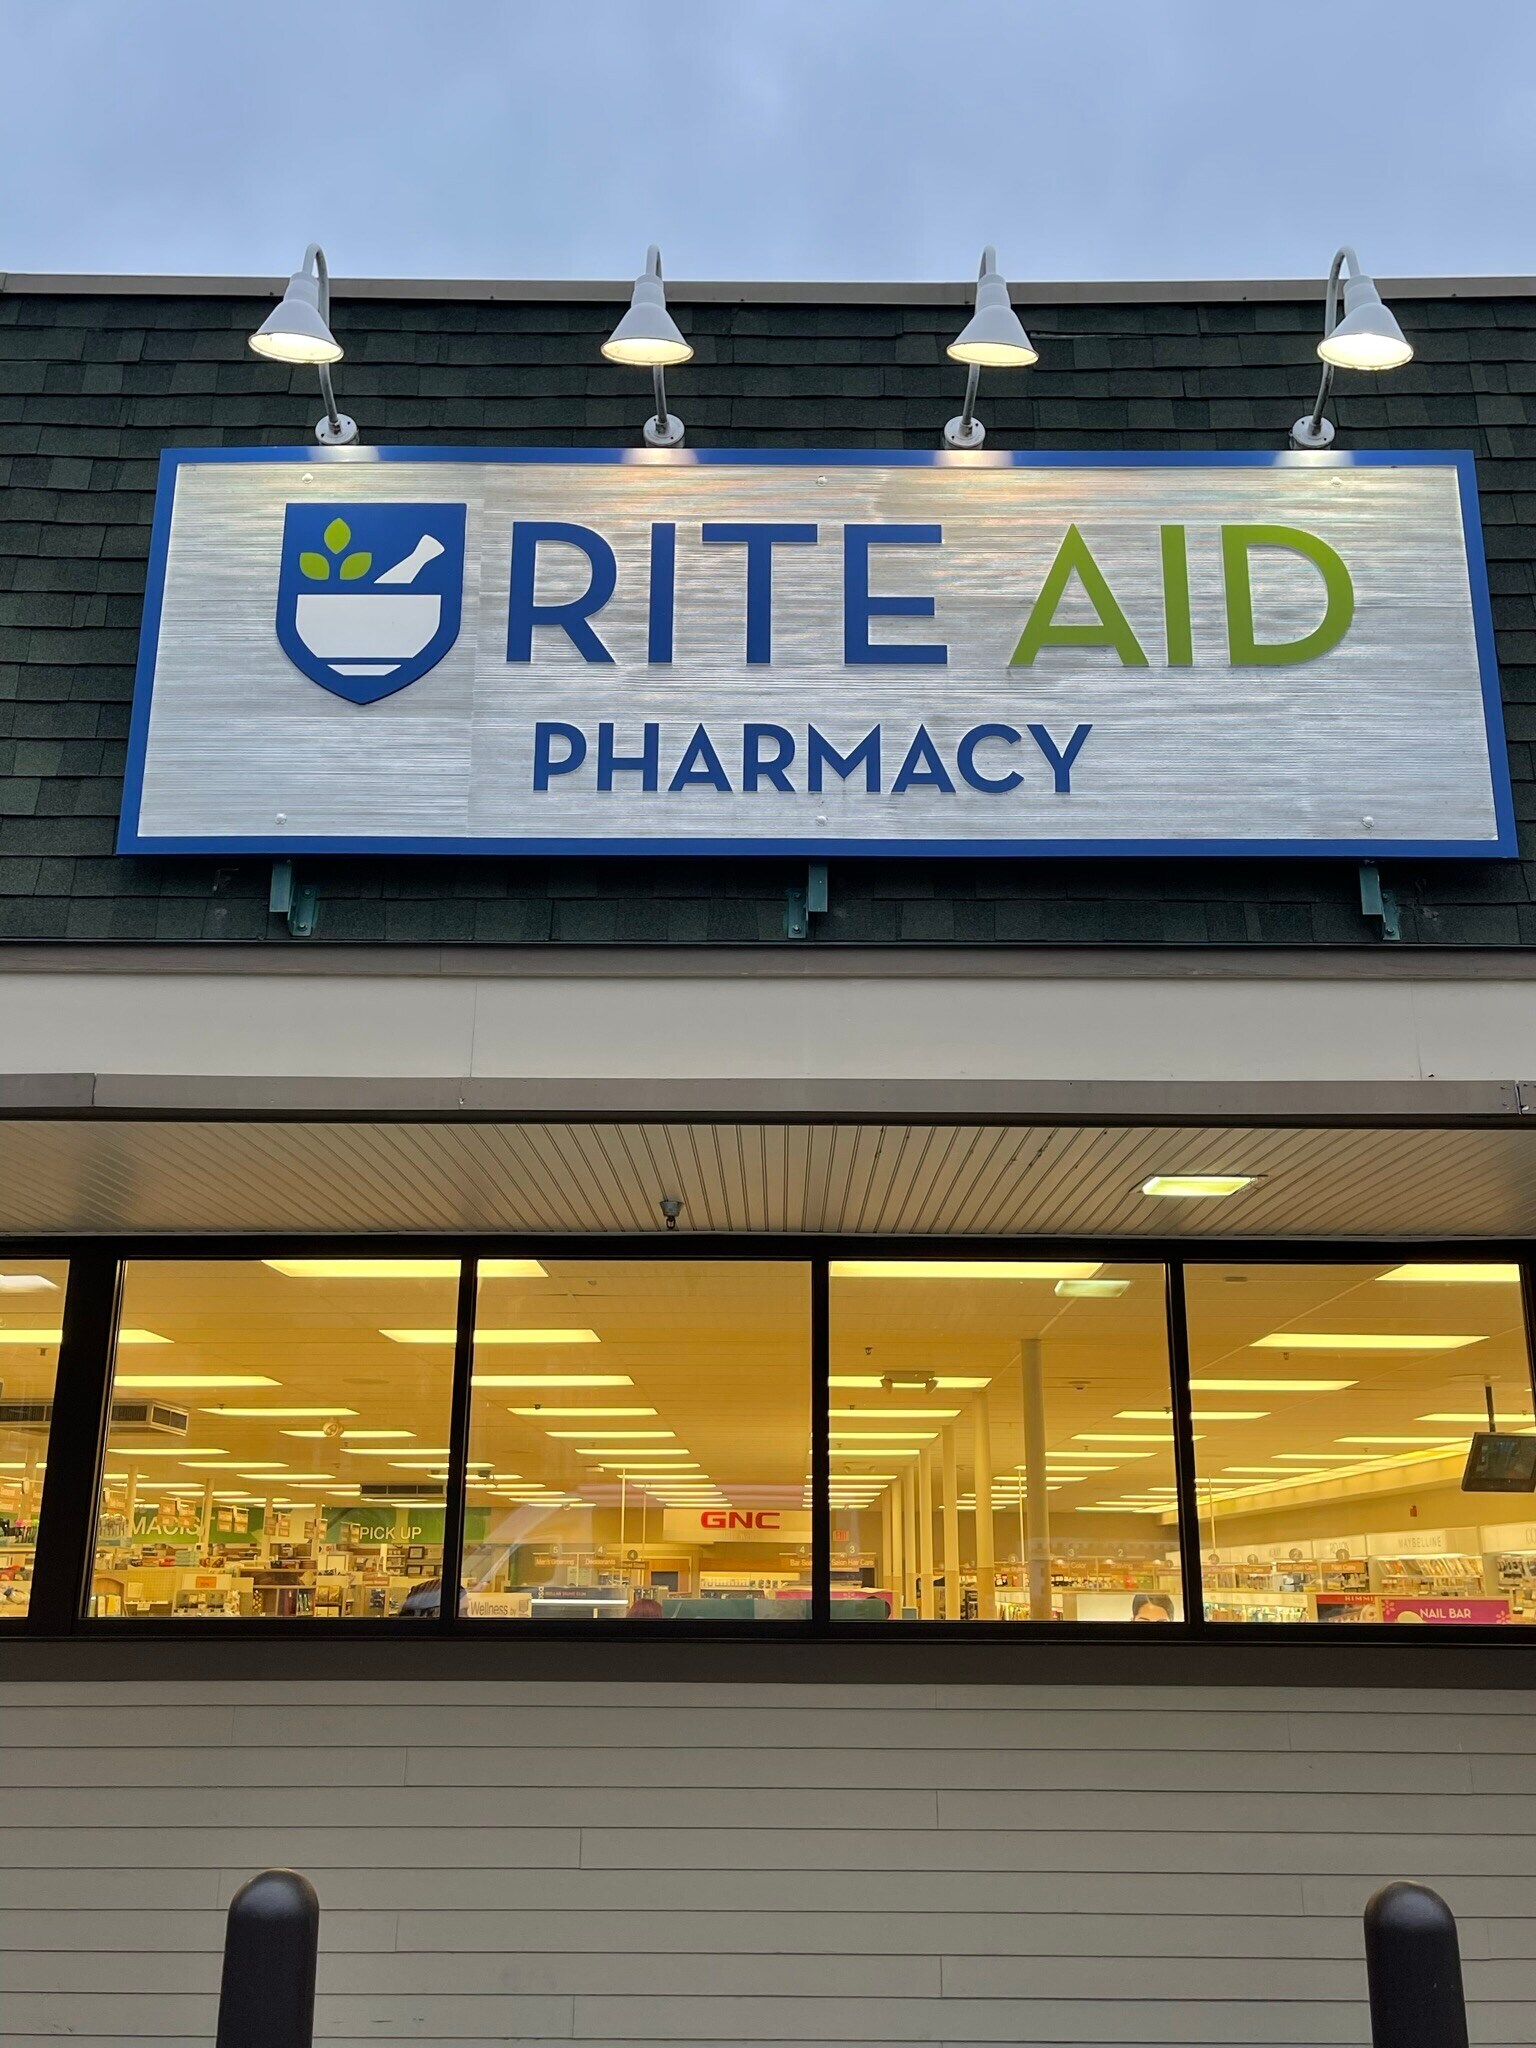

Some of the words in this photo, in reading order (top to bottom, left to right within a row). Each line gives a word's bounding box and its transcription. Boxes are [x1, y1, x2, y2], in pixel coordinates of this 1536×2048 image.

[506, 521, 948, 666] RITE
[1008, 522, 1355, 667] AID
[533, 722, 1093, 794] PHARMACY
[700, 1511, 781, 1529] GNC
[359, 1526, 396, 1540] PICK
[400, 1526, 422, 1540] UP
[1398, 1536, 1442, 1549] MAYBELLINE
[789, 1559, 799, 1567] Bar
[860, 1559, 875, 1567] Care
[470, 1601, 509, 1617] Wellness
[1419, 1608, 1447, 1619] NAIL
[1448, 1608, 1472, 1619] BAR
